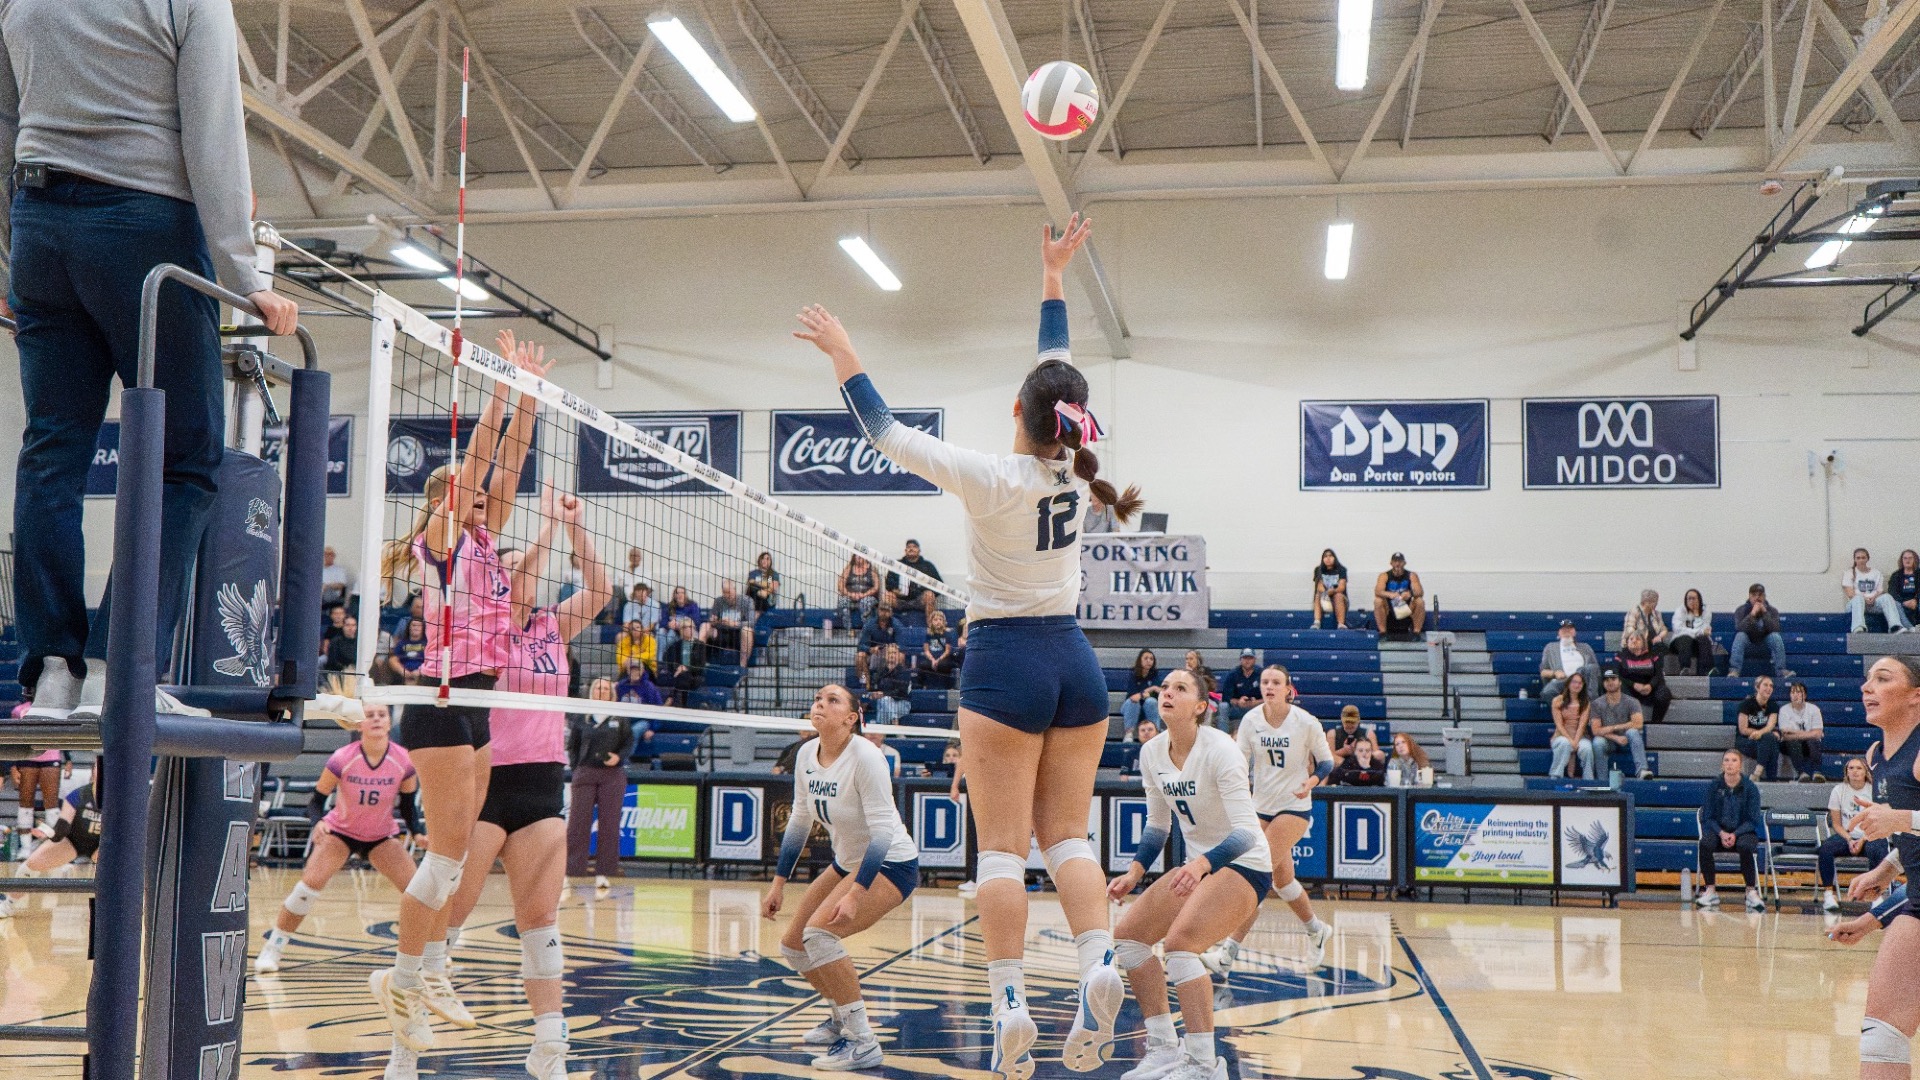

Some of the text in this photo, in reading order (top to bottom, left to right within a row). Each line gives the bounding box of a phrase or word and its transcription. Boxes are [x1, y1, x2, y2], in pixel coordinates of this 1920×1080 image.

[470, 345, 517, 380] BLUE HAWKS
[561, 391, 598, 421] BLUE HAWKS
[778, 425, 925, 476] Coca-Co
[1330, 465, 1456, 485] Dan Porter Motors
[1556, 453, 1677, 484] MIDCO
[1036, 489, 1081, 552] 12
[1080, 545, 1189, 562] PORTING
[1111, 570, 1198, 593] HAWK
[1076, 604, 1182, 621] LETICS
[1261, 737, 1290, 748] HAWKS
[1267, 750, 1285, 768] 13
[347, 775, 395, 786] BELLEVUE
[809, 779, 837, 798] HAWKS
[1163, 780, 1196, 797] HAWKS
[359, 790, 380, 806] 16
[620, 806, 688, 830] TORAMA
[814, 799, 832, 825] 11
[1176, 800, 1196, 826] 9
[1487, 818, 1549, 829] Reinventing the
[1340, 803, 1385, 865] D
[1482, 829, 1549, 839] printing industry.
[1292, 845, 1314, 858] RD
[1471, 850, 1523, 862] Shop local
